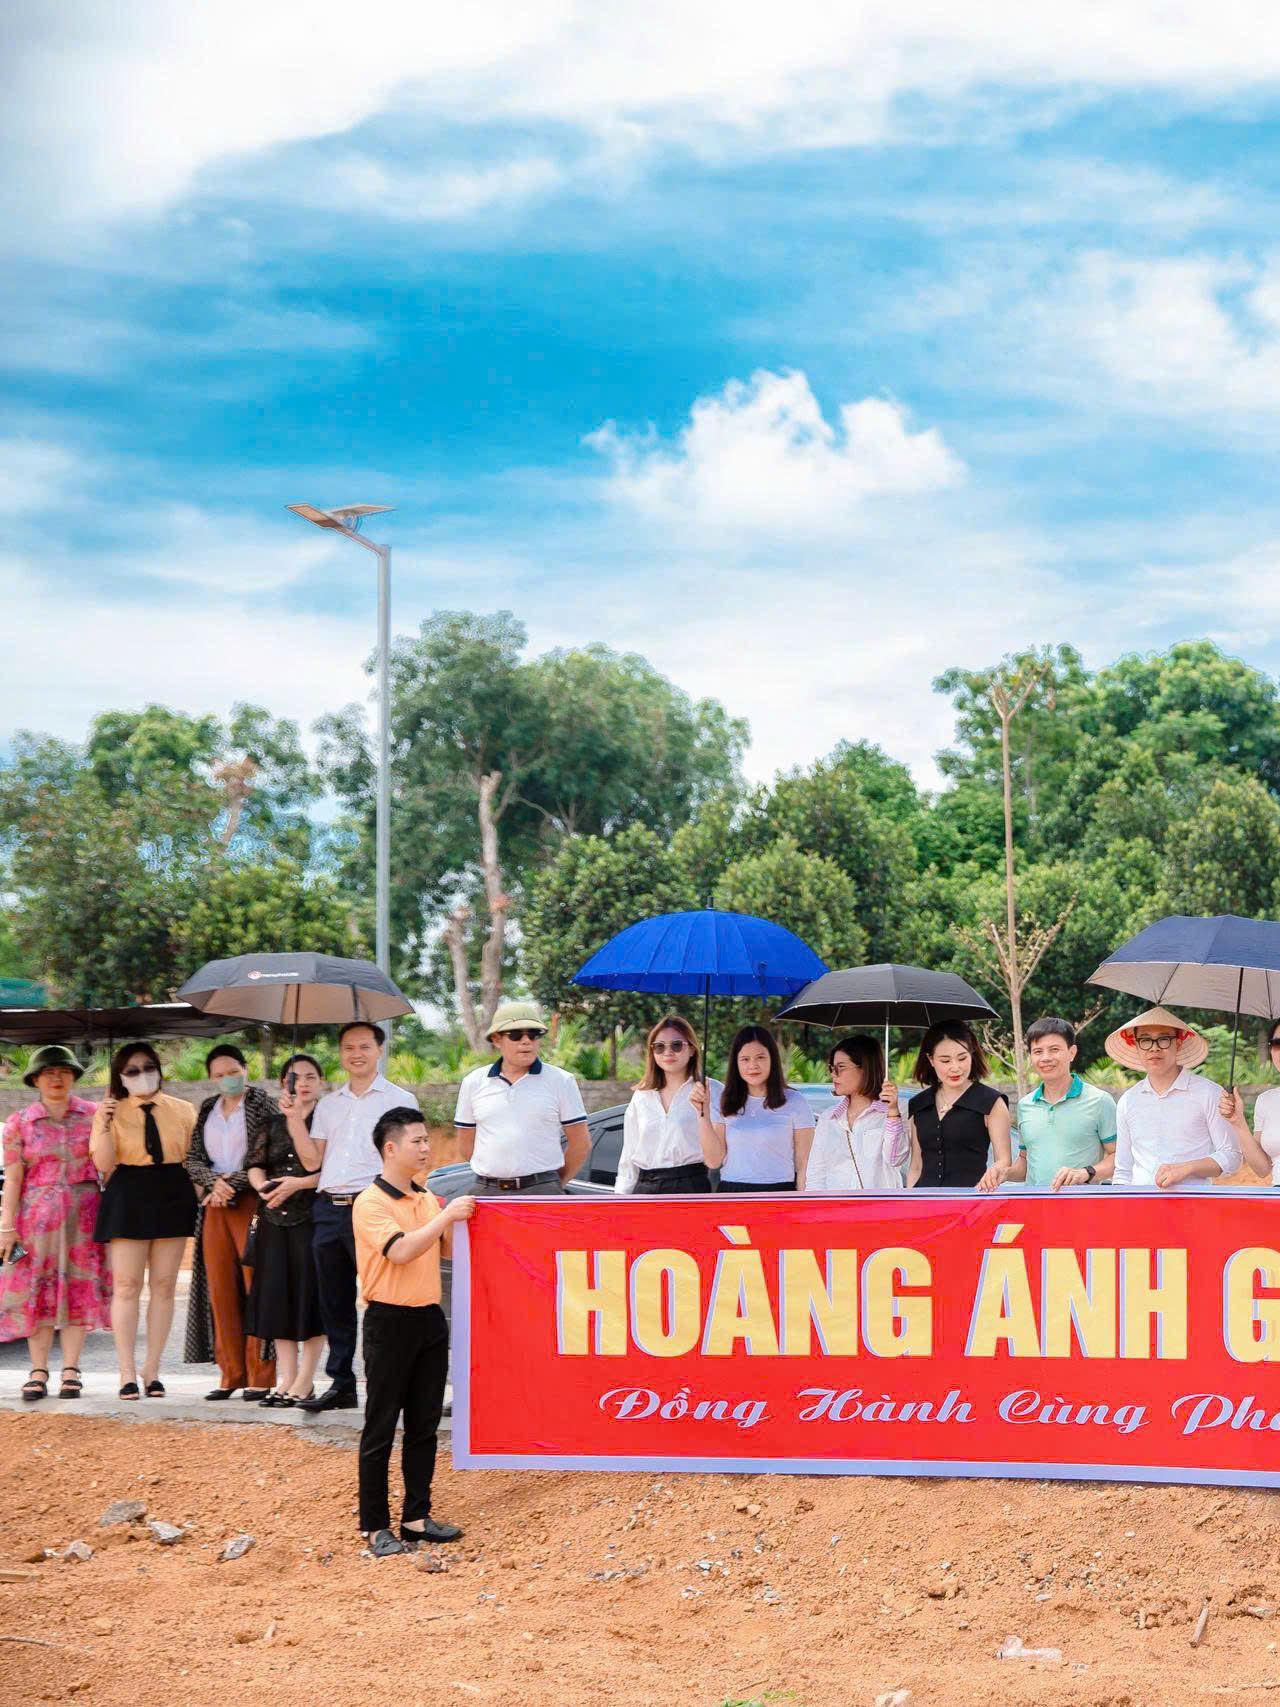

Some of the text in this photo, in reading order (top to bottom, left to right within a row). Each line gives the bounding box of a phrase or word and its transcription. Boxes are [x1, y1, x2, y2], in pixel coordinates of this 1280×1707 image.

[555, 1225, 933, 1357] HOÀNG
[963, 1223, 1188, 1360] ÁNH
[599, 1386, 771, 1428] Đồng
[796, 1387, 977, 1424] Hành
[998, 1389, 1152, 1434] Cùng
